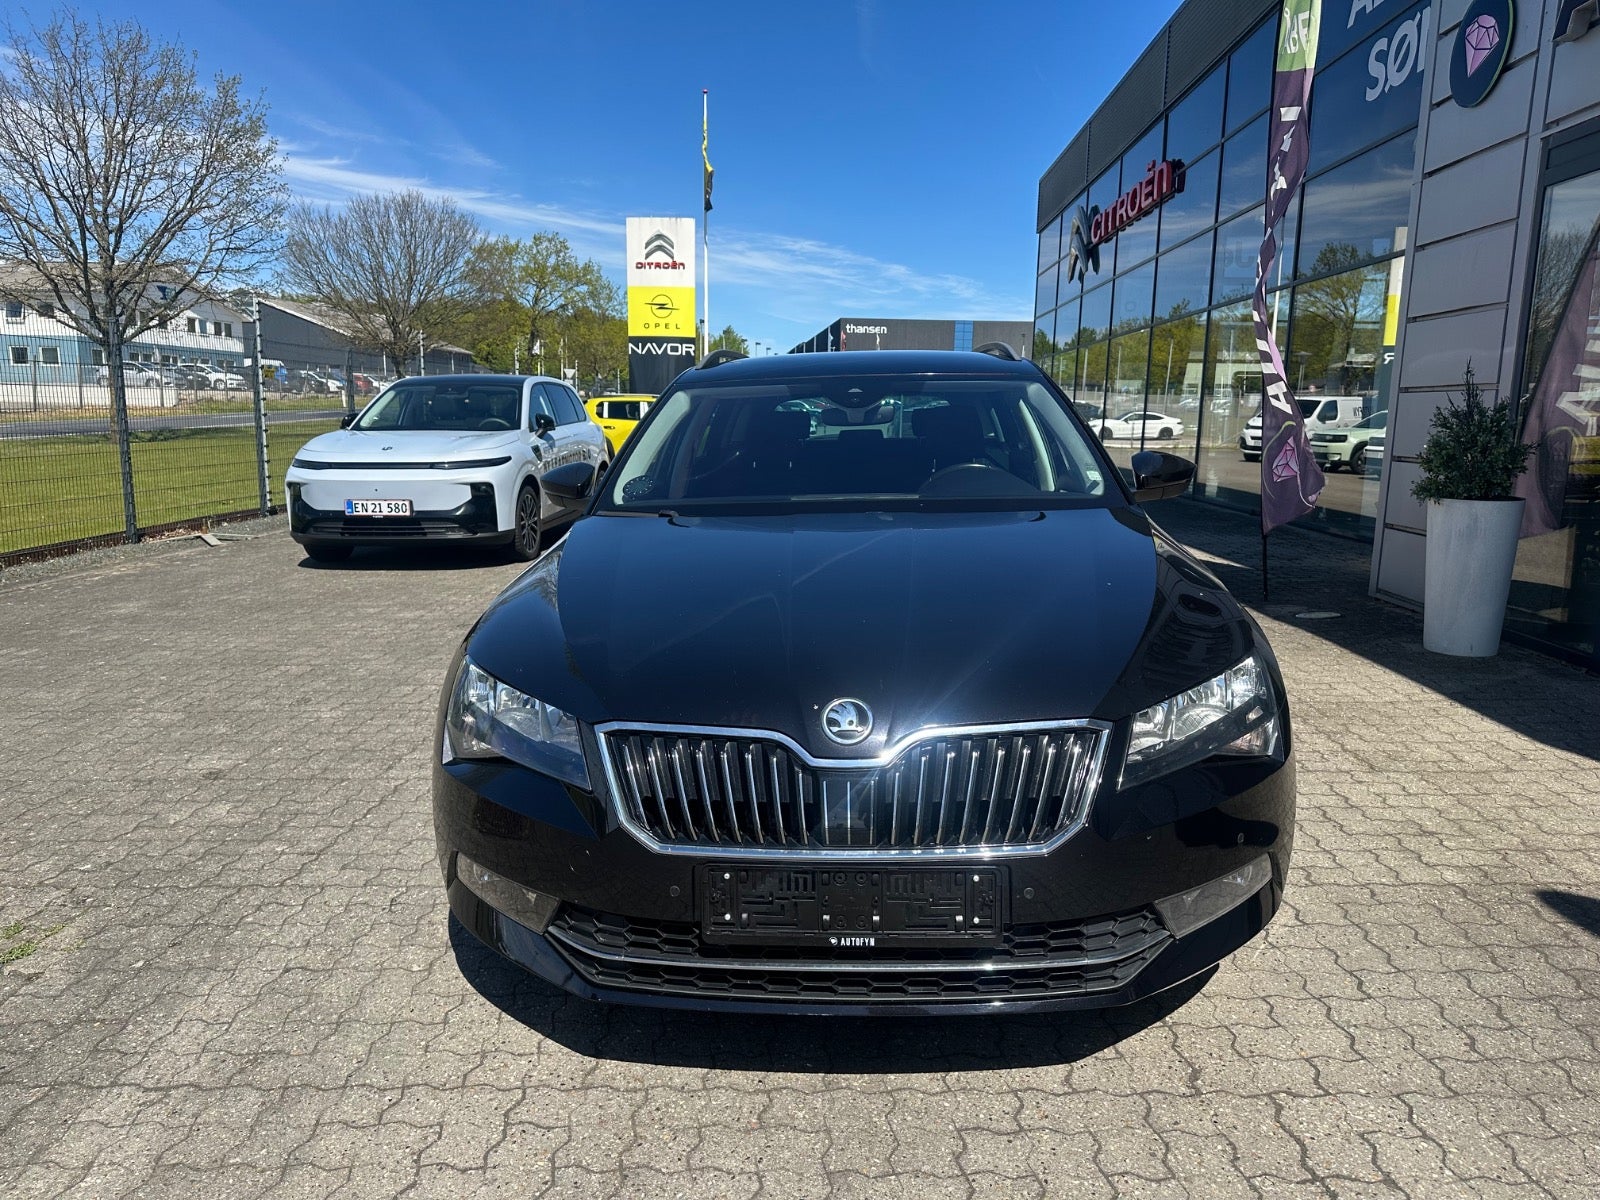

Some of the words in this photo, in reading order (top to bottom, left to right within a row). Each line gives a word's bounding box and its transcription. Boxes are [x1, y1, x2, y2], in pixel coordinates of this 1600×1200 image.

[1091, 160, 1171, 244] CITROËN
[643, 322, 681, 330] OPEL
[845, 323, 887, 334] thansen
[628, 343, 695, 356] NAVOR
[354, 502, 368, 513] EN
[371, 502, 383, 513] 21
[387, 502, 407, 513] 580
[840, 937, 875, 946] AUTOFYN
